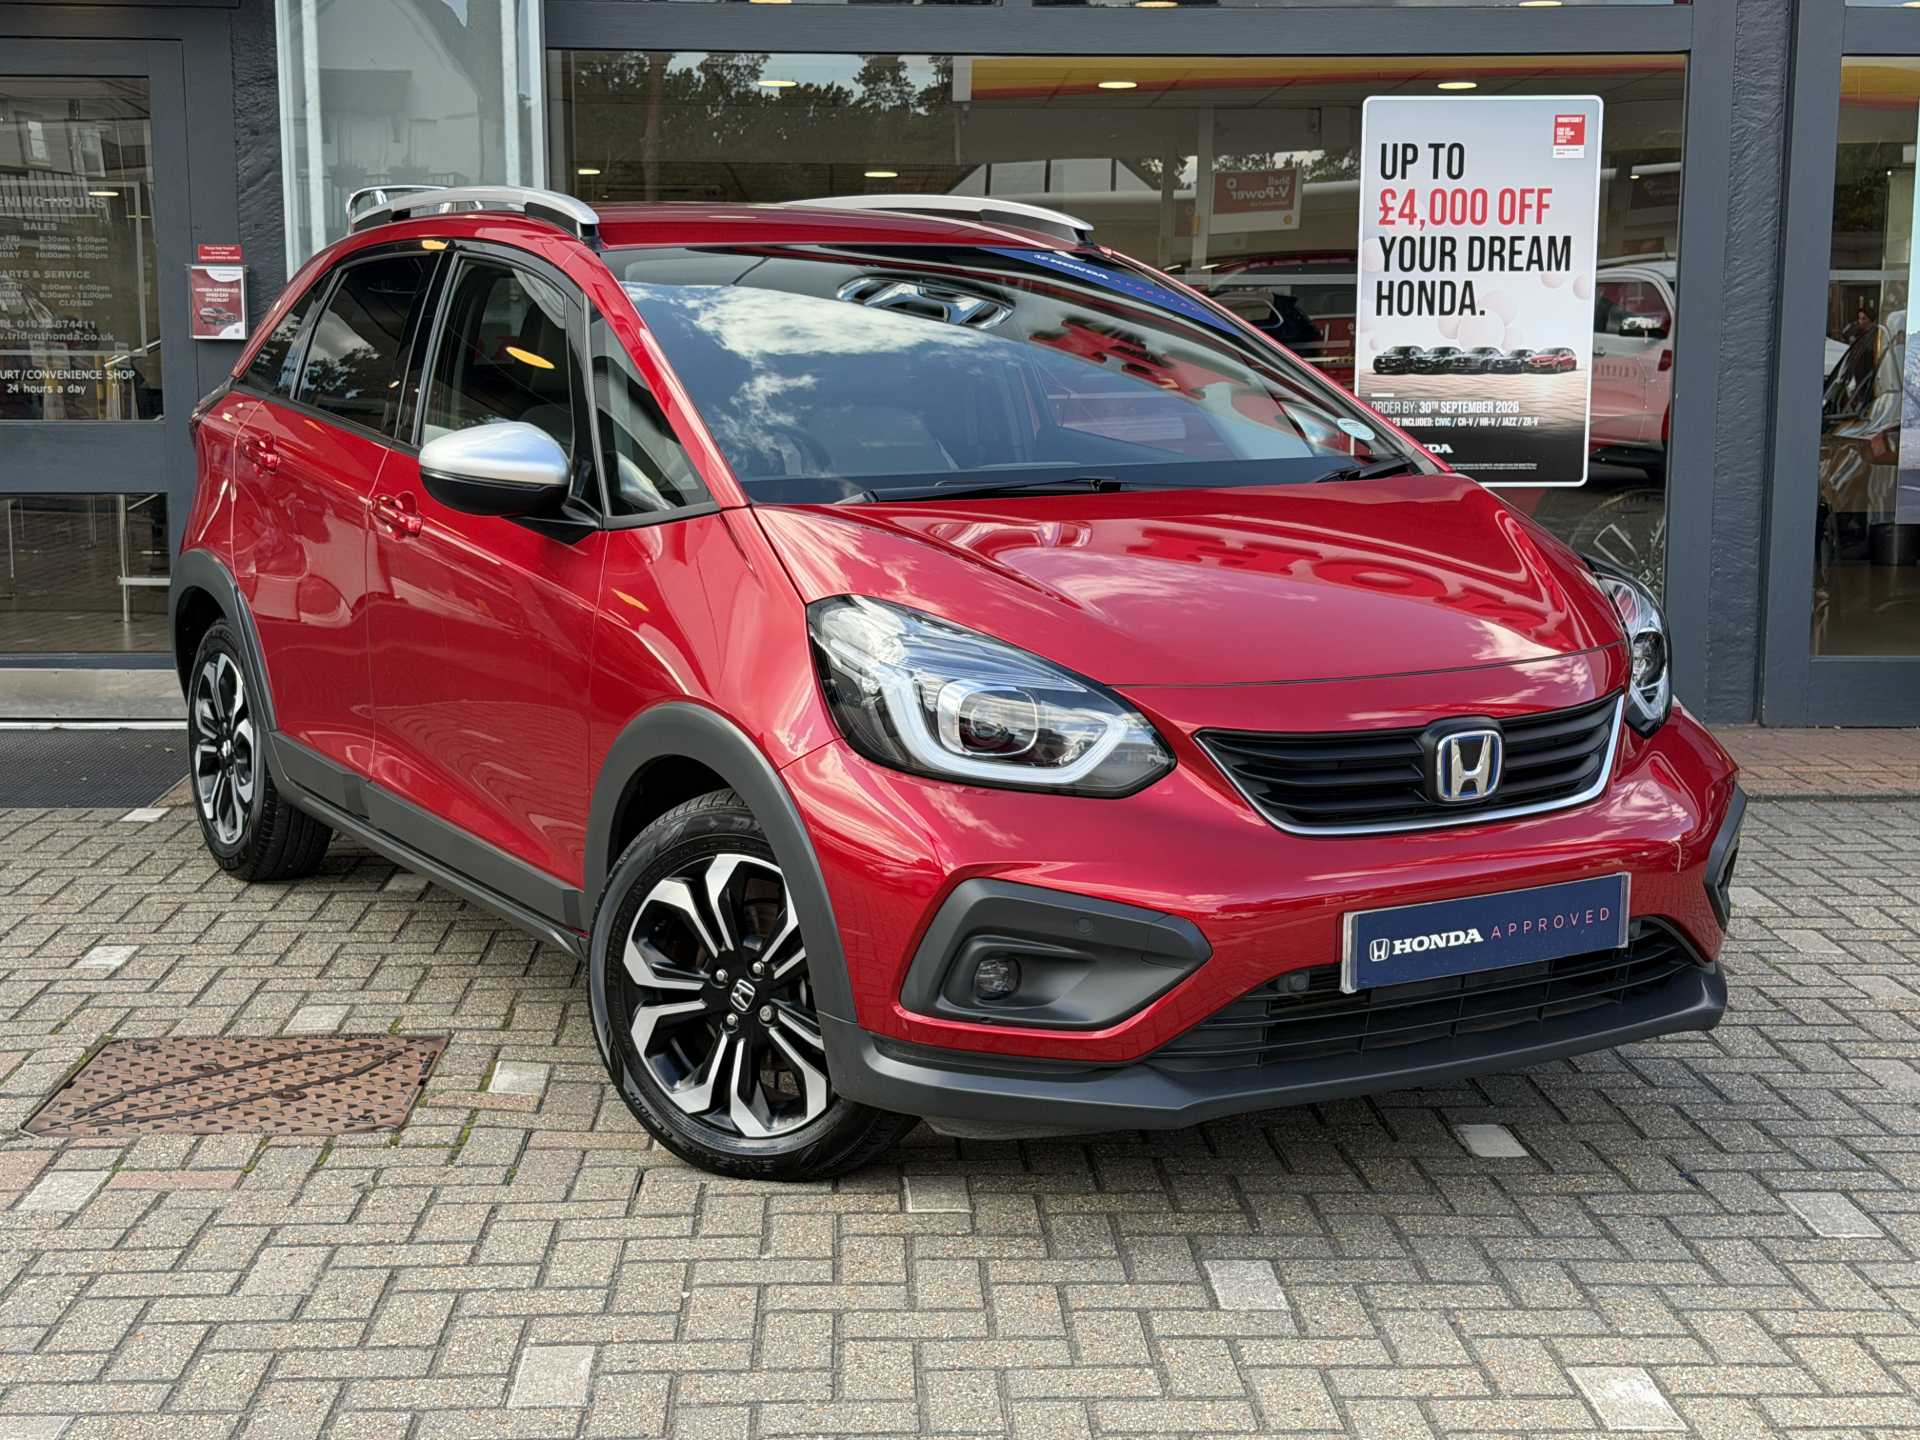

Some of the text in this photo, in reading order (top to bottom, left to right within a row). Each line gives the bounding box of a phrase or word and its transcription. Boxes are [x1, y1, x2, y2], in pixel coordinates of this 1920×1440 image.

[1380, 142, 1465, 180] UP TO
[1378, 188, 1553, 231] £4,000 OFF
[23, 222, 57, 231] SALES
[1379, 235, 1572, 272] YOUR DREAM
[0, 270, 29, 279] ARTS
[44, 270, 91, 279] SERVICE
[1376, 280, 1486, 317] HONDA.
[106, 368, 136, 380] SHOP
[7, 384, 19, 393] 24
[23, 384, 53, 393] hours
[67, 384, 86, 395] day
[1402, 401, 1417, 414] BY:
[1440, 400, 1494, 414] SEPTEMBER
[1392, 928, 1484, 955] HONDA
[1491, 907, 1611, 939] APPROVED
